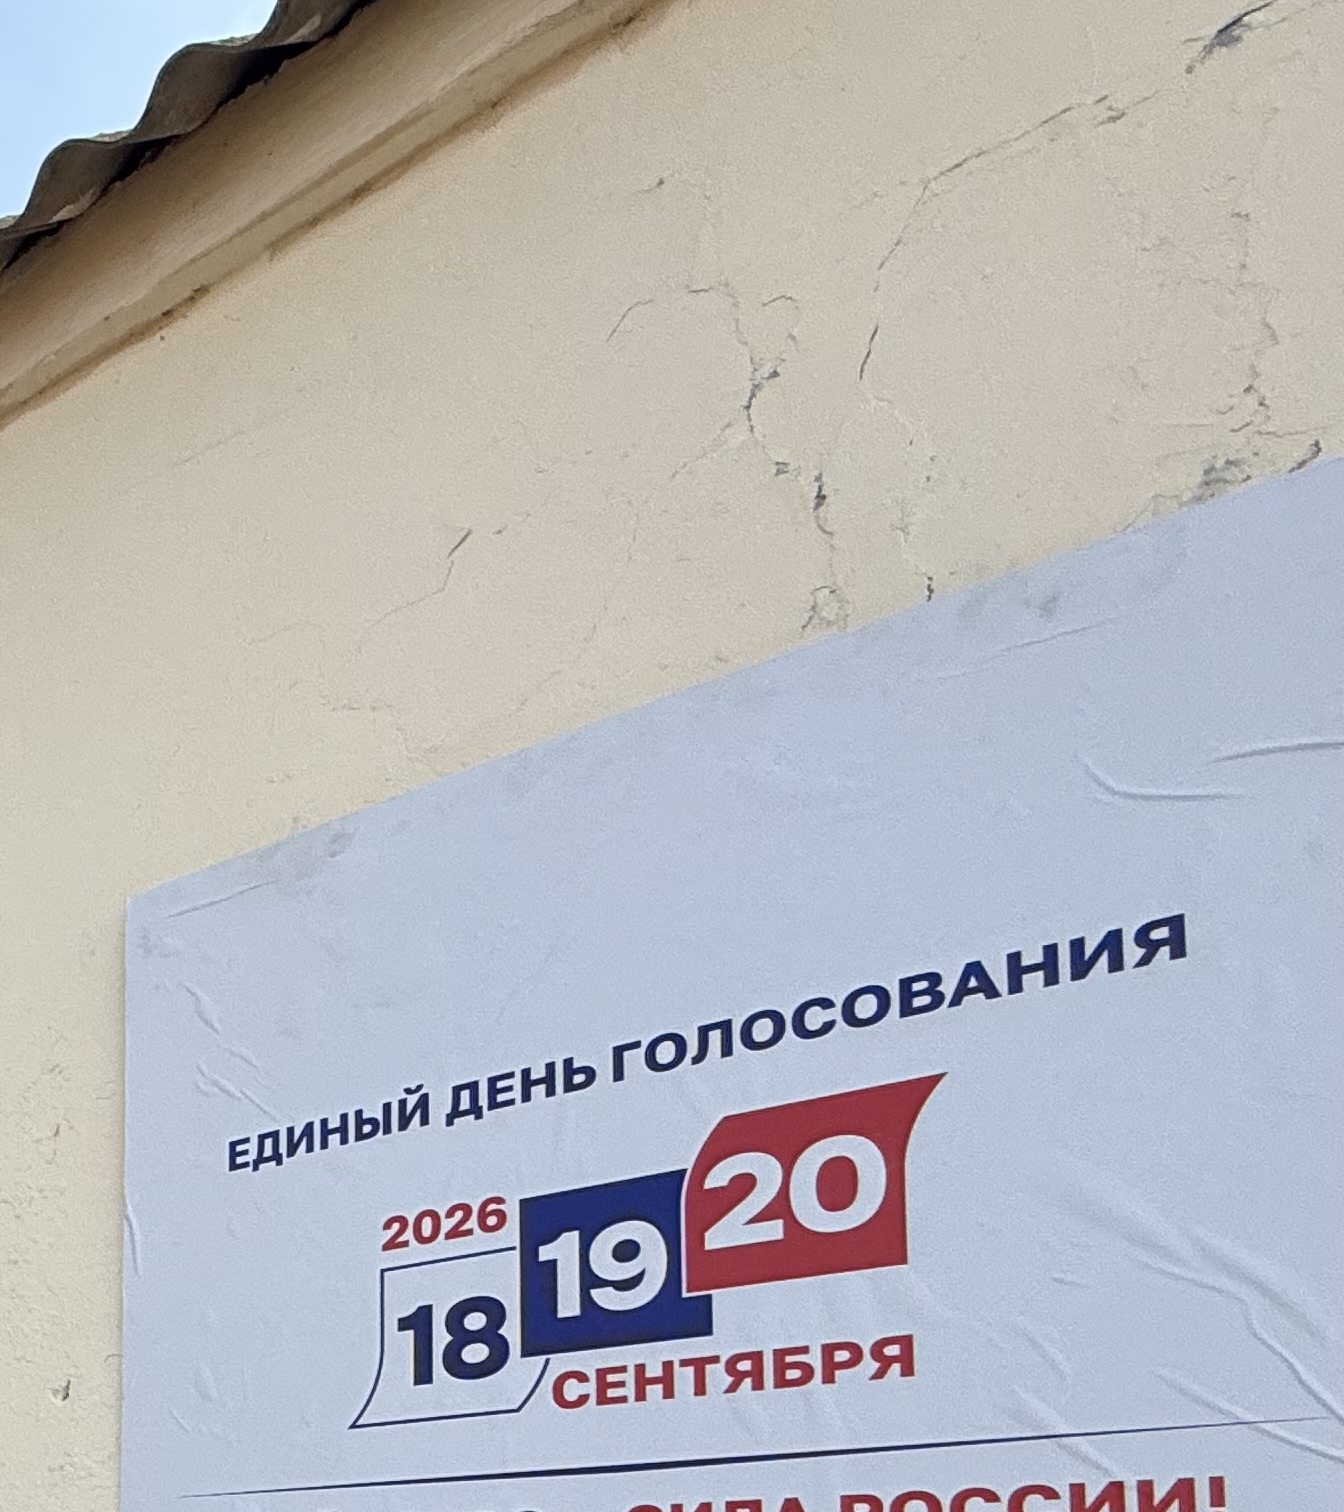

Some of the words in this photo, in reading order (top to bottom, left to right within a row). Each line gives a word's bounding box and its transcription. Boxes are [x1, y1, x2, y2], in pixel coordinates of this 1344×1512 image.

[226, 1082, 431, 1174] ЕДИНЫЙ
[444, 1055, 598, 1129] ДЕНЬ
[611, 911, 1189, 1084] ГОЛОСОВАНИЯ
[380, 1195, 508, 1253] 2026
[396, 1294, 511, 1388] 18
[537, 1217, 670, 1321] 19
[701, 1133, 889, 1251] 20
[551, 1333, 916, 1411] СЕНТЯБРЯ
